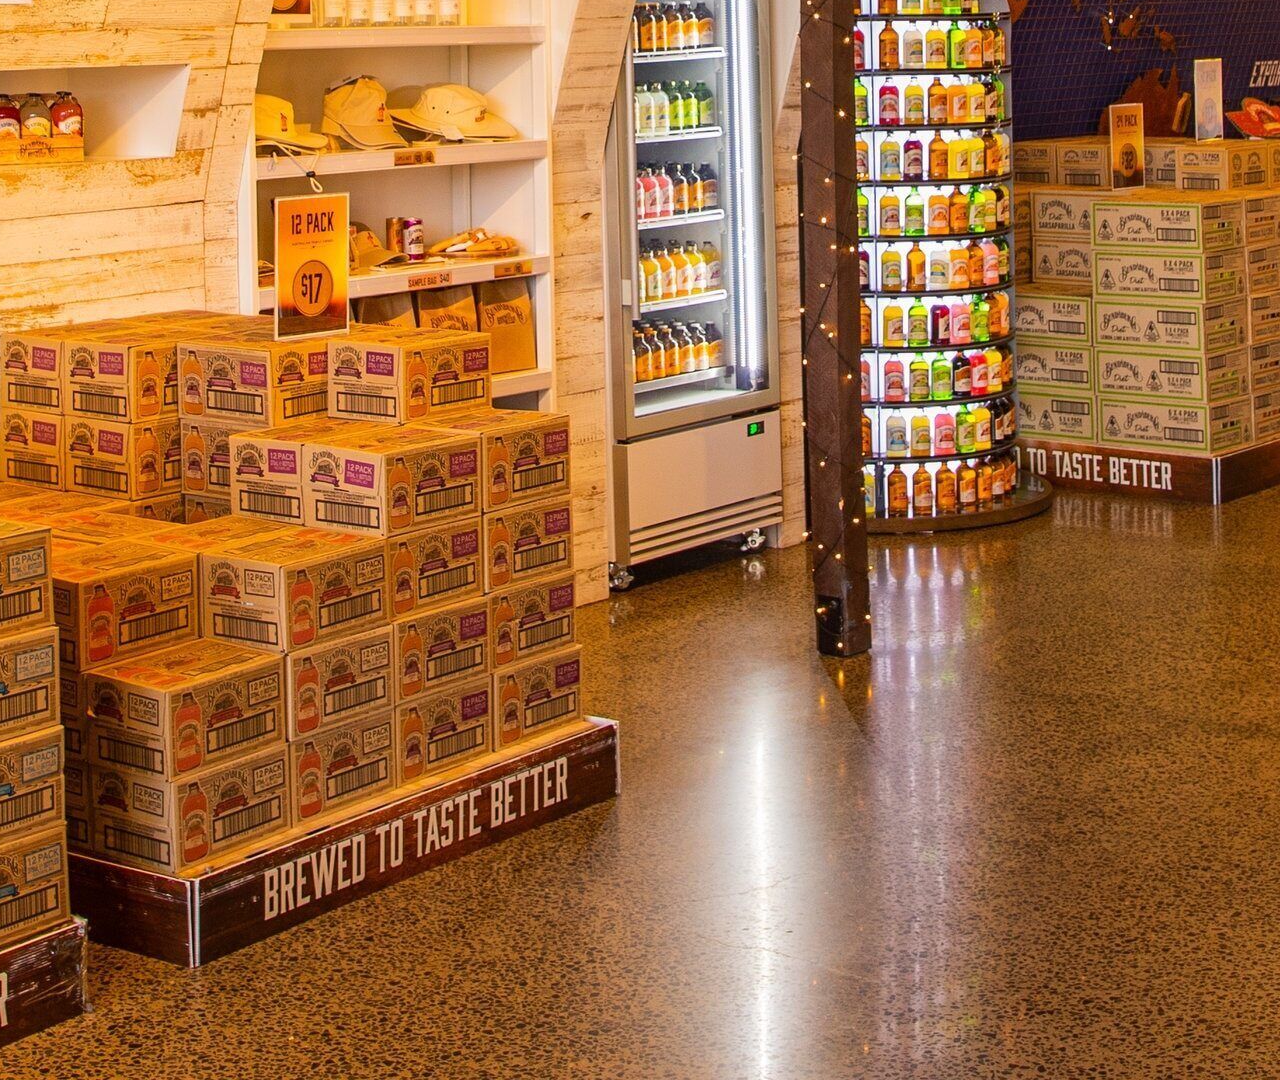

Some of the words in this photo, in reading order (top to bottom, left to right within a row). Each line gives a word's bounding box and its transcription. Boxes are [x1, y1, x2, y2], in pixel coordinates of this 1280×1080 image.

[1125, 114, 1137, 127] PACK
[291, 214, 302, 235] 12
[307, 211, 334, 233] PACK
[1038, 221, 1075, 230] SARSAPARILLA
[408, 278, 427, 288] SAMPLE
[428, 276, 437, 285] BAG
[440, 273, 450, 284] $40
[301, 273, 324, 304] $17
[355, 464, 372, 473] PACK
[1026, 448, 1047, 476] TO
[1052, 450, 1103, 483] TASTE
[1109, 457, 1172, 491] BETTER
[256, 573, 273, 584] PACK
[139, 698, 157, 711] PACK
[264, 834, 366, 921] BREWED
[375, 818, 404, 873] TO
[413, 789, 482, 859] TASTE
[490, 756, 568, 829] BETTER
